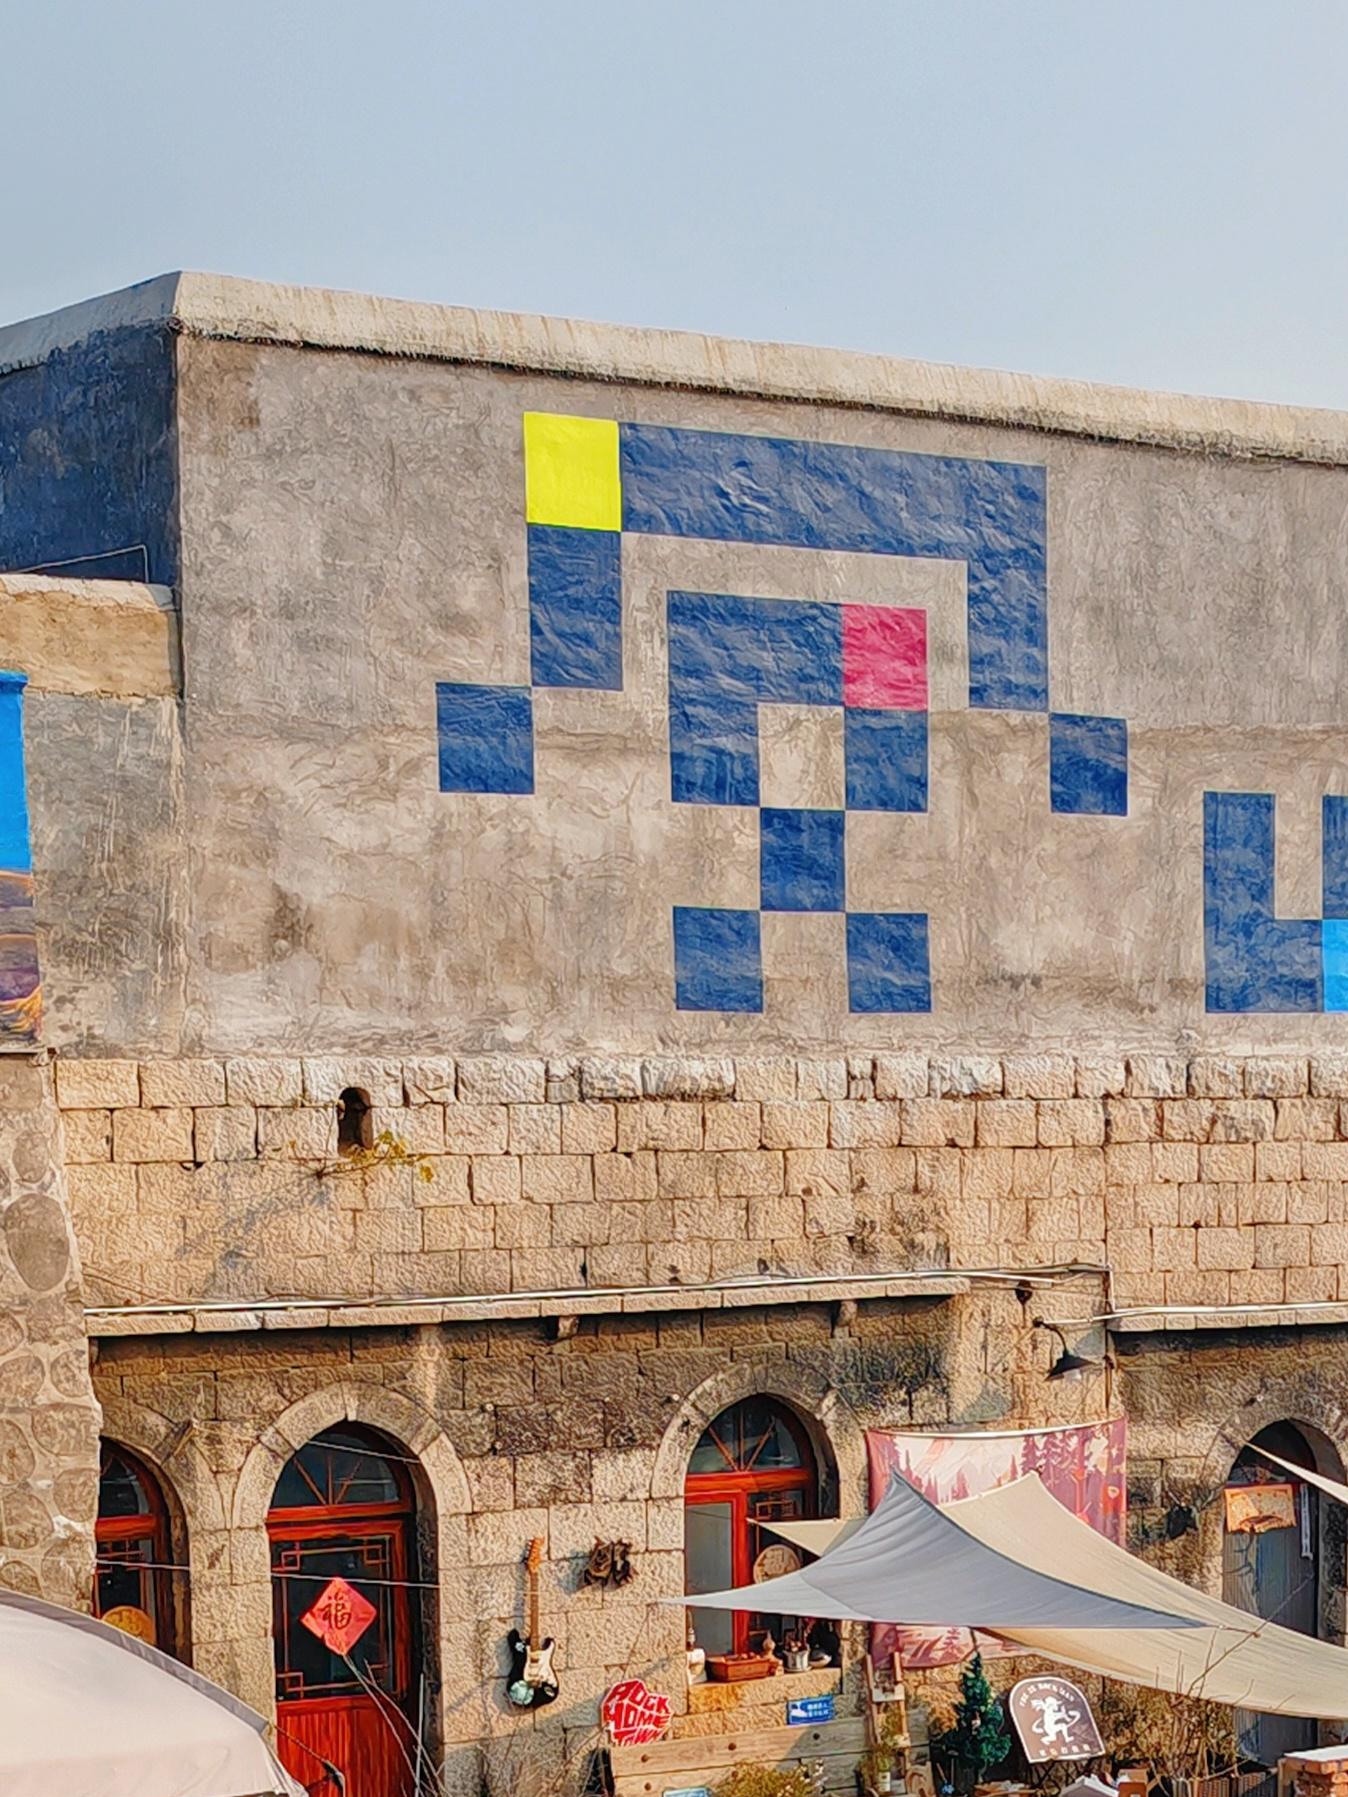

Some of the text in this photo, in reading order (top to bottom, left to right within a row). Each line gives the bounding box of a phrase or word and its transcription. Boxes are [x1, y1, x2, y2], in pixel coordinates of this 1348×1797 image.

[317, 1588, 352, 1630] 福
[606, 1680, 671, 1715] ROCK
[603, 1702, 671, 1730] HOME
